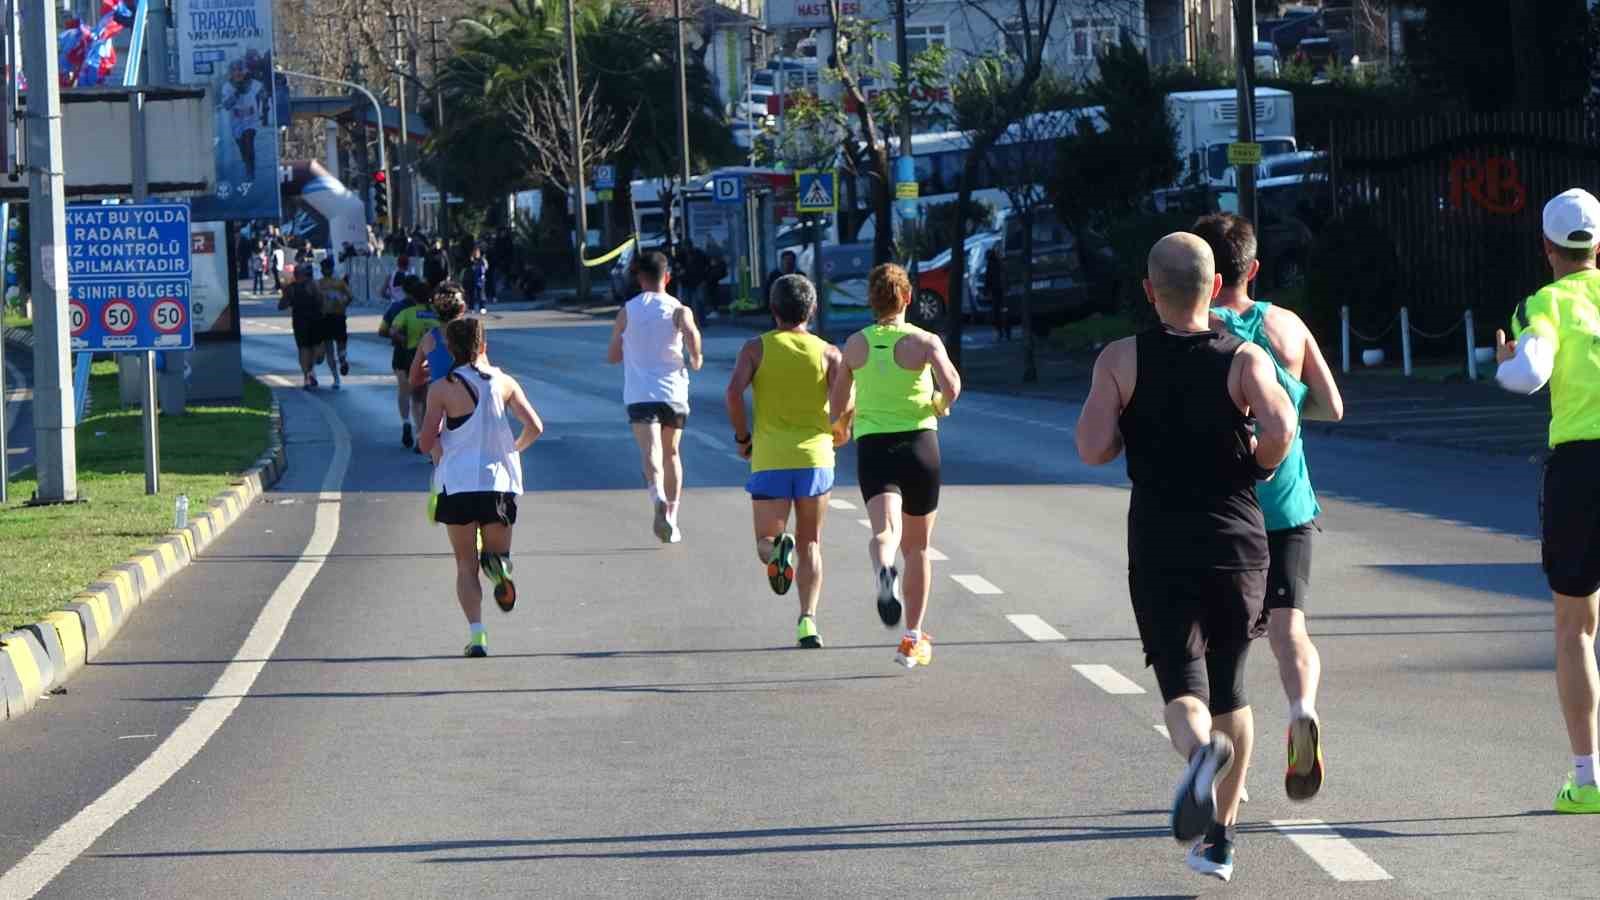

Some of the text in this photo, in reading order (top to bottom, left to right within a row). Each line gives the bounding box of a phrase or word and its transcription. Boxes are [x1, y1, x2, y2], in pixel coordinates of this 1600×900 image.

[798, 3, 862, 16] HASTESİ
[189, 9, 257, 31] TRABZON
[720, 180, 734, 197] D
[108, 211, 129, 224] BU
[134, 210, 185, 223] YOLDA
[74, 226, 159, 241] RADARLA
[88, 240, 180, 257] KONTROLÜ
[78, 286, 122, 299] SINIRI
[127, 281, 188, 298] BÖLGESİ
[108, 309, 131, 326] 50
[157, 308, 180, 324] 50
